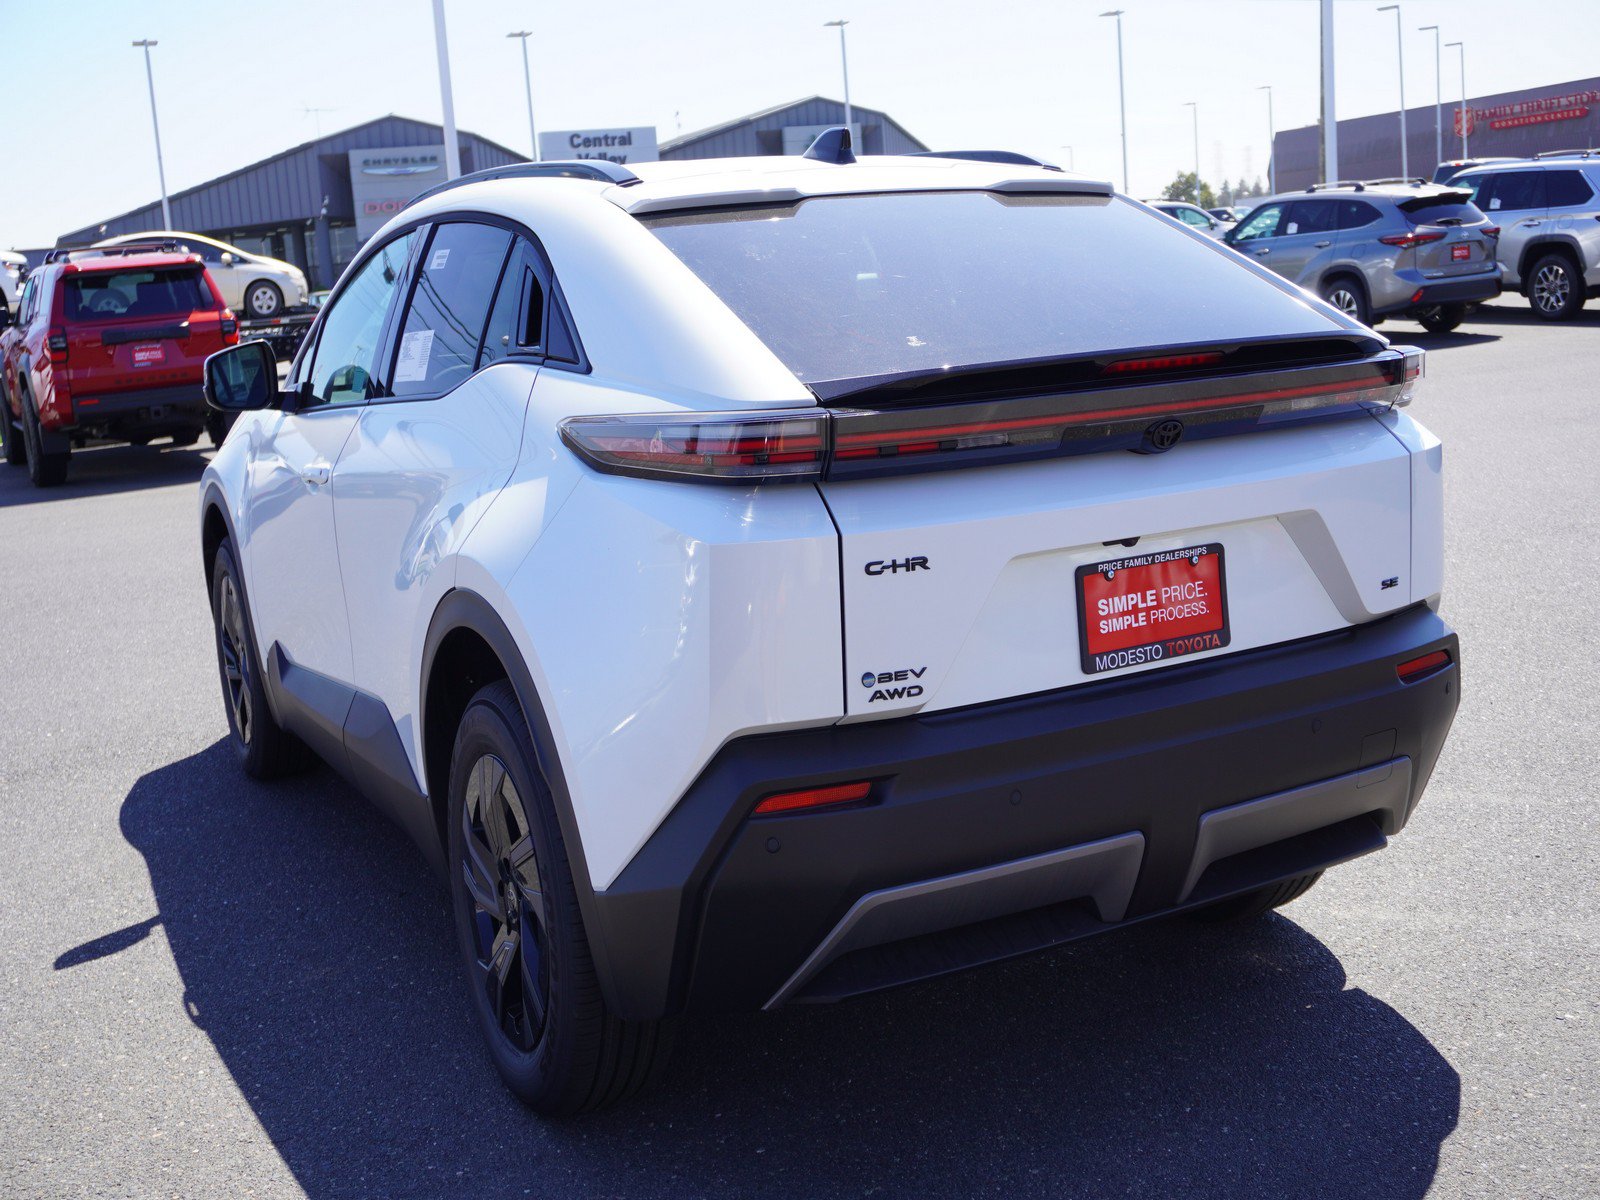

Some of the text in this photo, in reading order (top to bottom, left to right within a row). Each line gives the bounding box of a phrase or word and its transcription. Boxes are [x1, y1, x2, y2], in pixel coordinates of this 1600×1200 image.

[1475, 104, 1515, 121] FAMILY
[1518, 97, 1562, 115] THRIFT
[1494, 109, 1581, 128] DONATION CENTER
[569, 131, 632, 148] Central
[362, 155, 438, 166] CHRYSLER
[576, 152, 627, 165] lley
[864, 556, 931, 576] C-HR
[1098, 546, 1208, 573] PRICE FAMILY DEALERSHIPS
[1381, 576, 1399, 590] SE
[1097, 581, 1208, 616] SIMPLE PRICE.
[1099, 601, 1210, 634] SIMPLE PROCESS.
[1095, 633, 1221, 671] MODESTO TOYOTA
[877, 666, 928, 684] BEV
[868, 685, 924, 703] AWD
